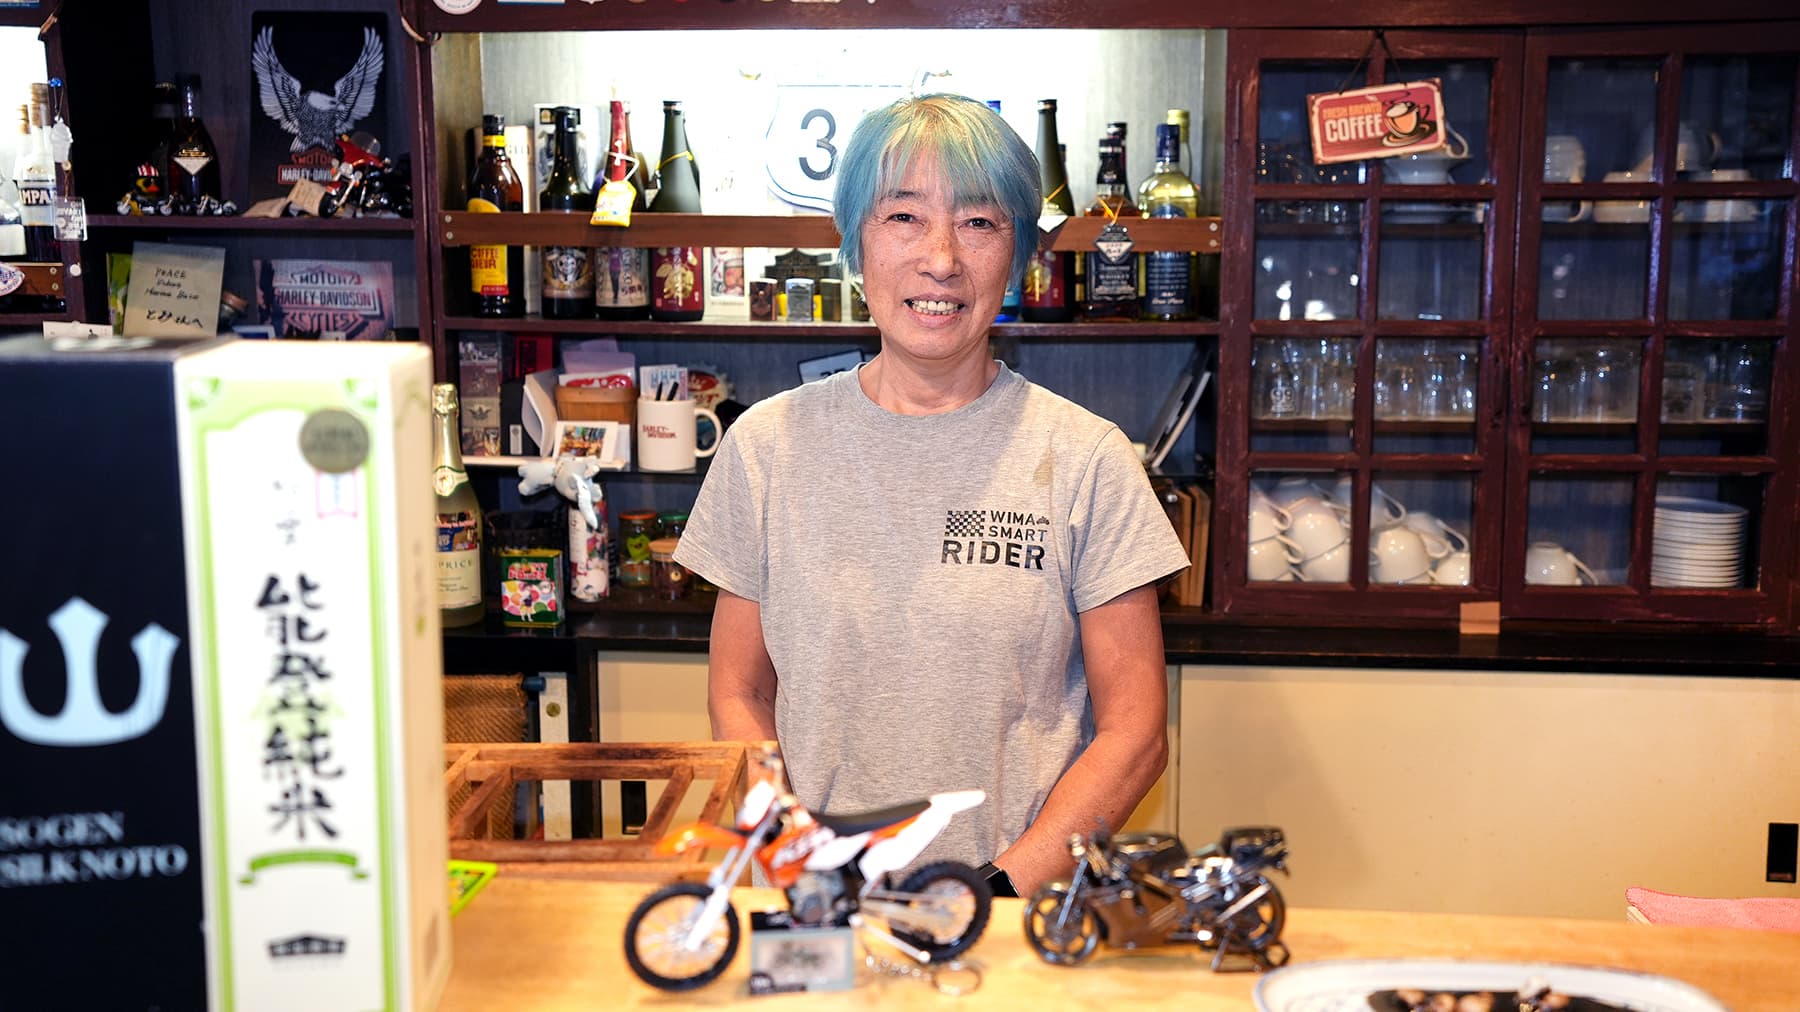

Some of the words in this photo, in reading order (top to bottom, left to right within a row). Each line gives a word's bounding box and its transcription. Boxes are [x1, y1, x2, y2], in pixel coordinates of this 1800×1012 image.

[1322, 106, 1348, 119] FRESH
[1324, 113, 1385, 143] COFFEE
[990, 509, 1036, 526] WIMA
[988, 525, 1048, 542] SMART
[941, 540, 1045, 570] RIDER
[0, 811, 125, 850] SOGEN
